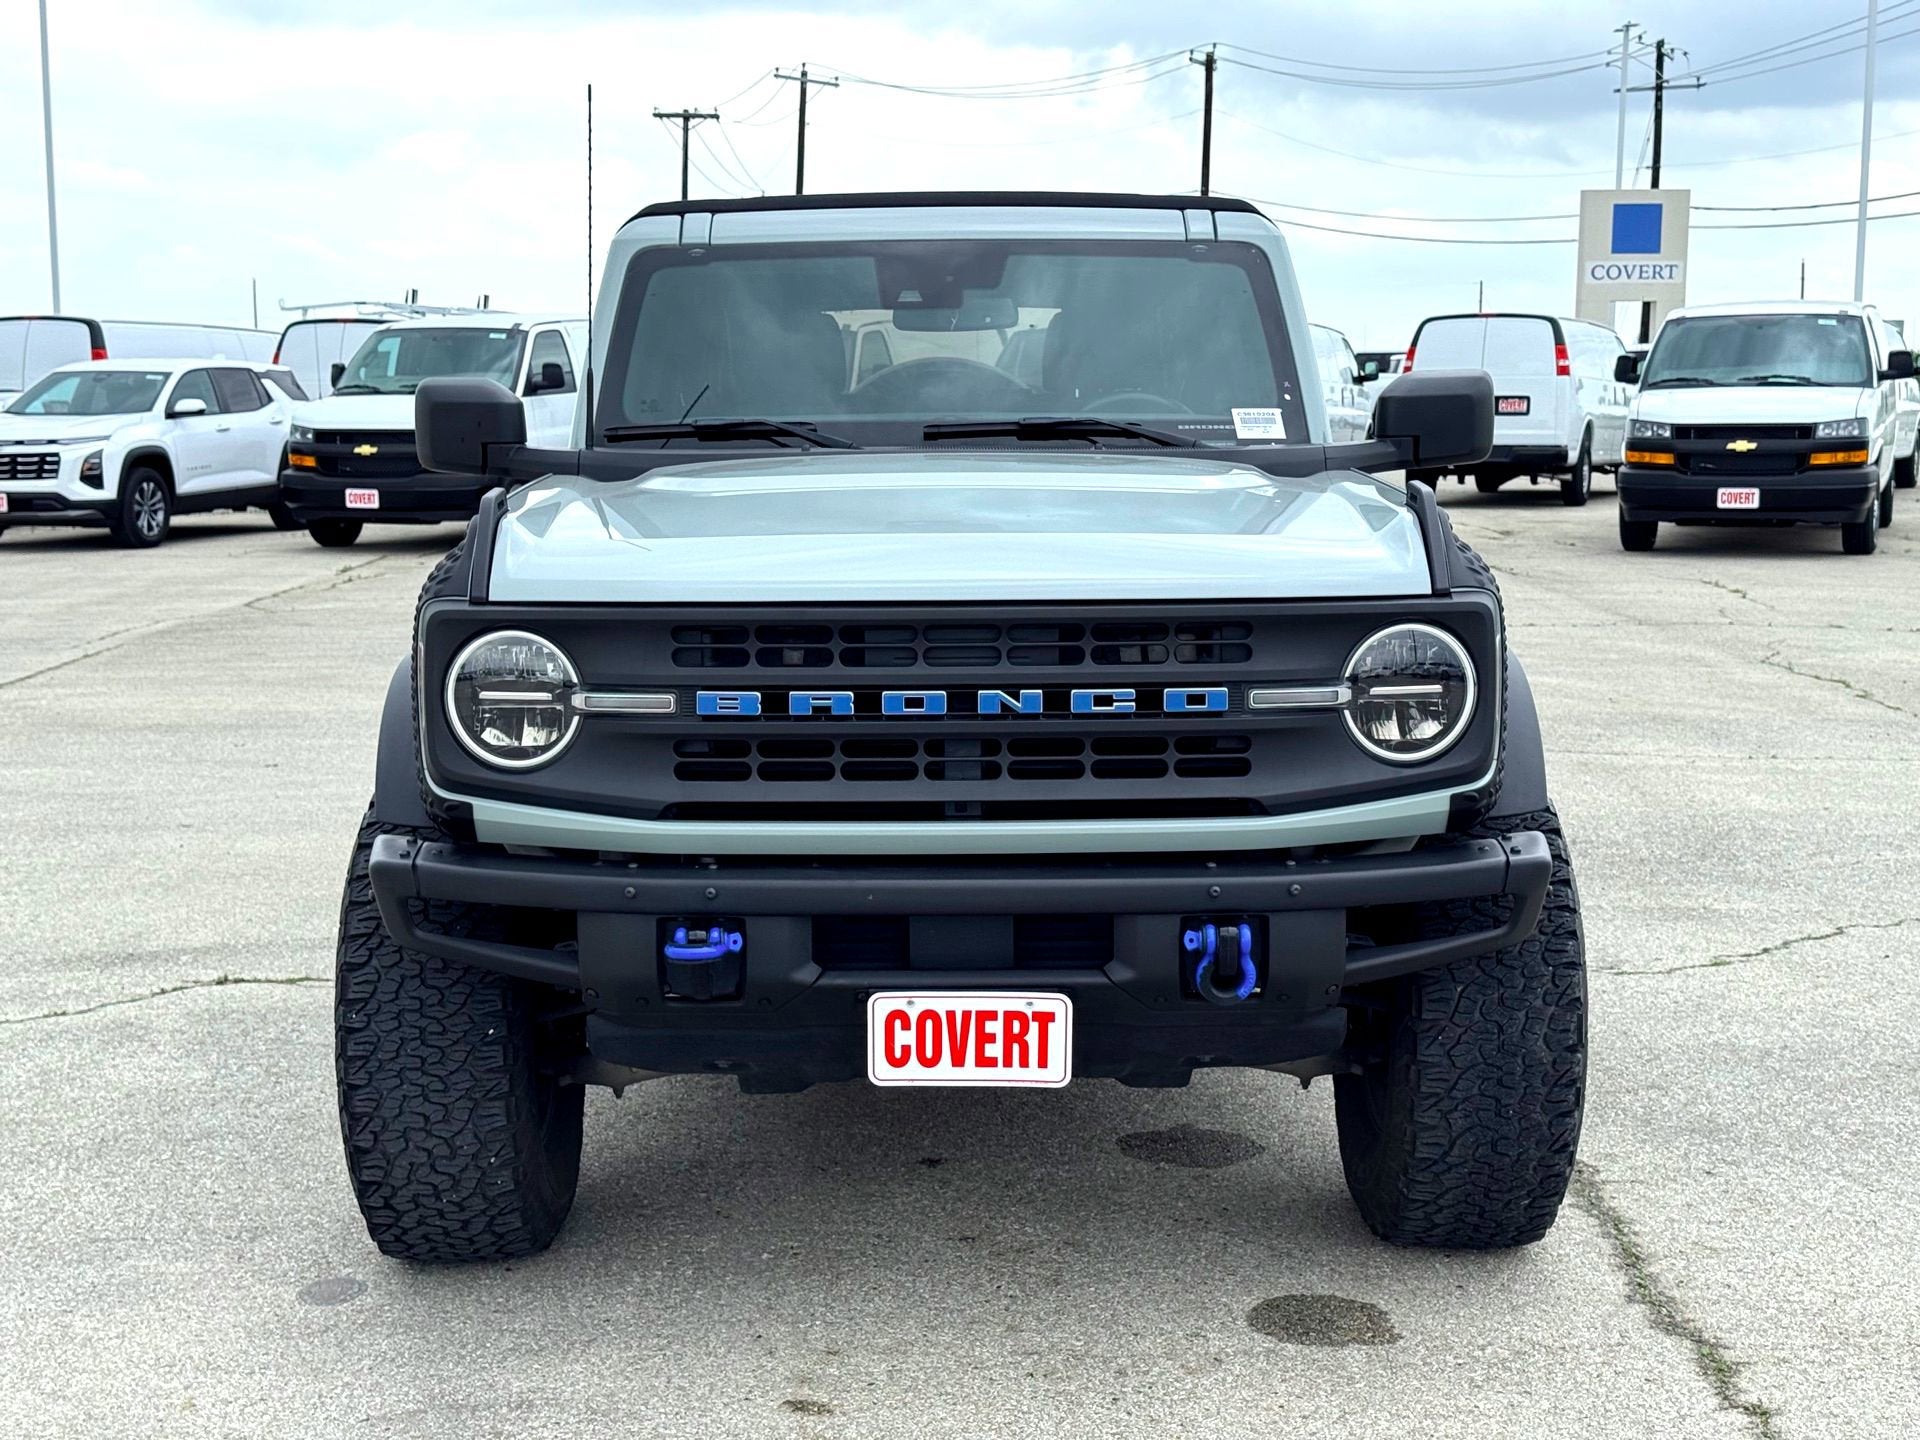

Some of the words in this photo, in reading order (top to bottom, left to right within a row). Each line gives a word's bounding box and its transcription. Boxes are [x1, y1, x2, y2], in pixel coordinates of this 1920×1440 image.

[1591, 264, 1679, 281] COVERT
[348, 493, 376, 504] COVERT
[1720, 491, 1756, 505] COVERT
[696, 687, 1229, 716] BRONCO
[884, 1009, 1056, 1069] COVERT
